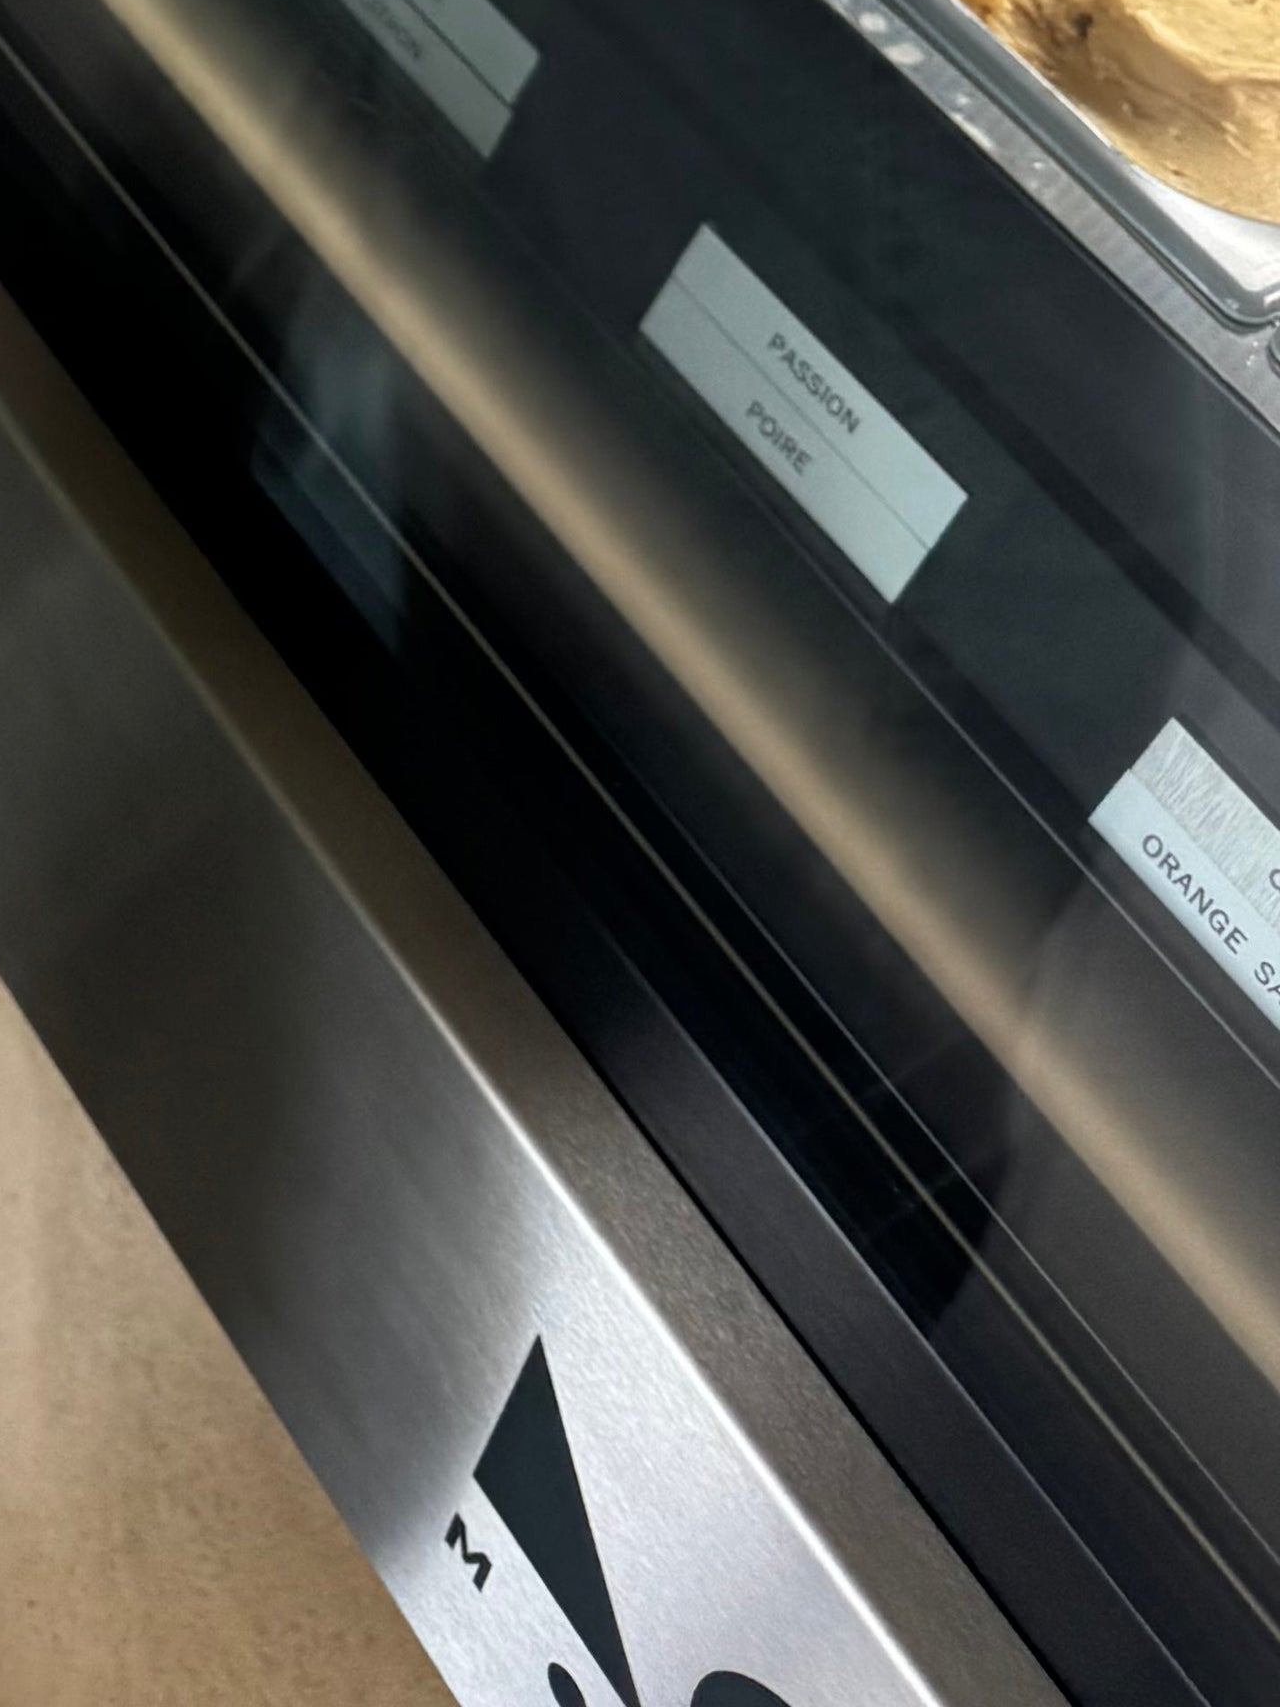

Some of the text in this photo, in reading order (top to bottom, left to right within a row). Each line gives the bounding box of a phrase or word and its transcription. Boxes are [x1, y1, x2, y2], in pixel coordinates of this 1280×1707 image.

[767, 332, 861, 434] PASSION
[745, 399, 813, 477] POIRE
[1142, 834, 1248, 955] ORANGE
